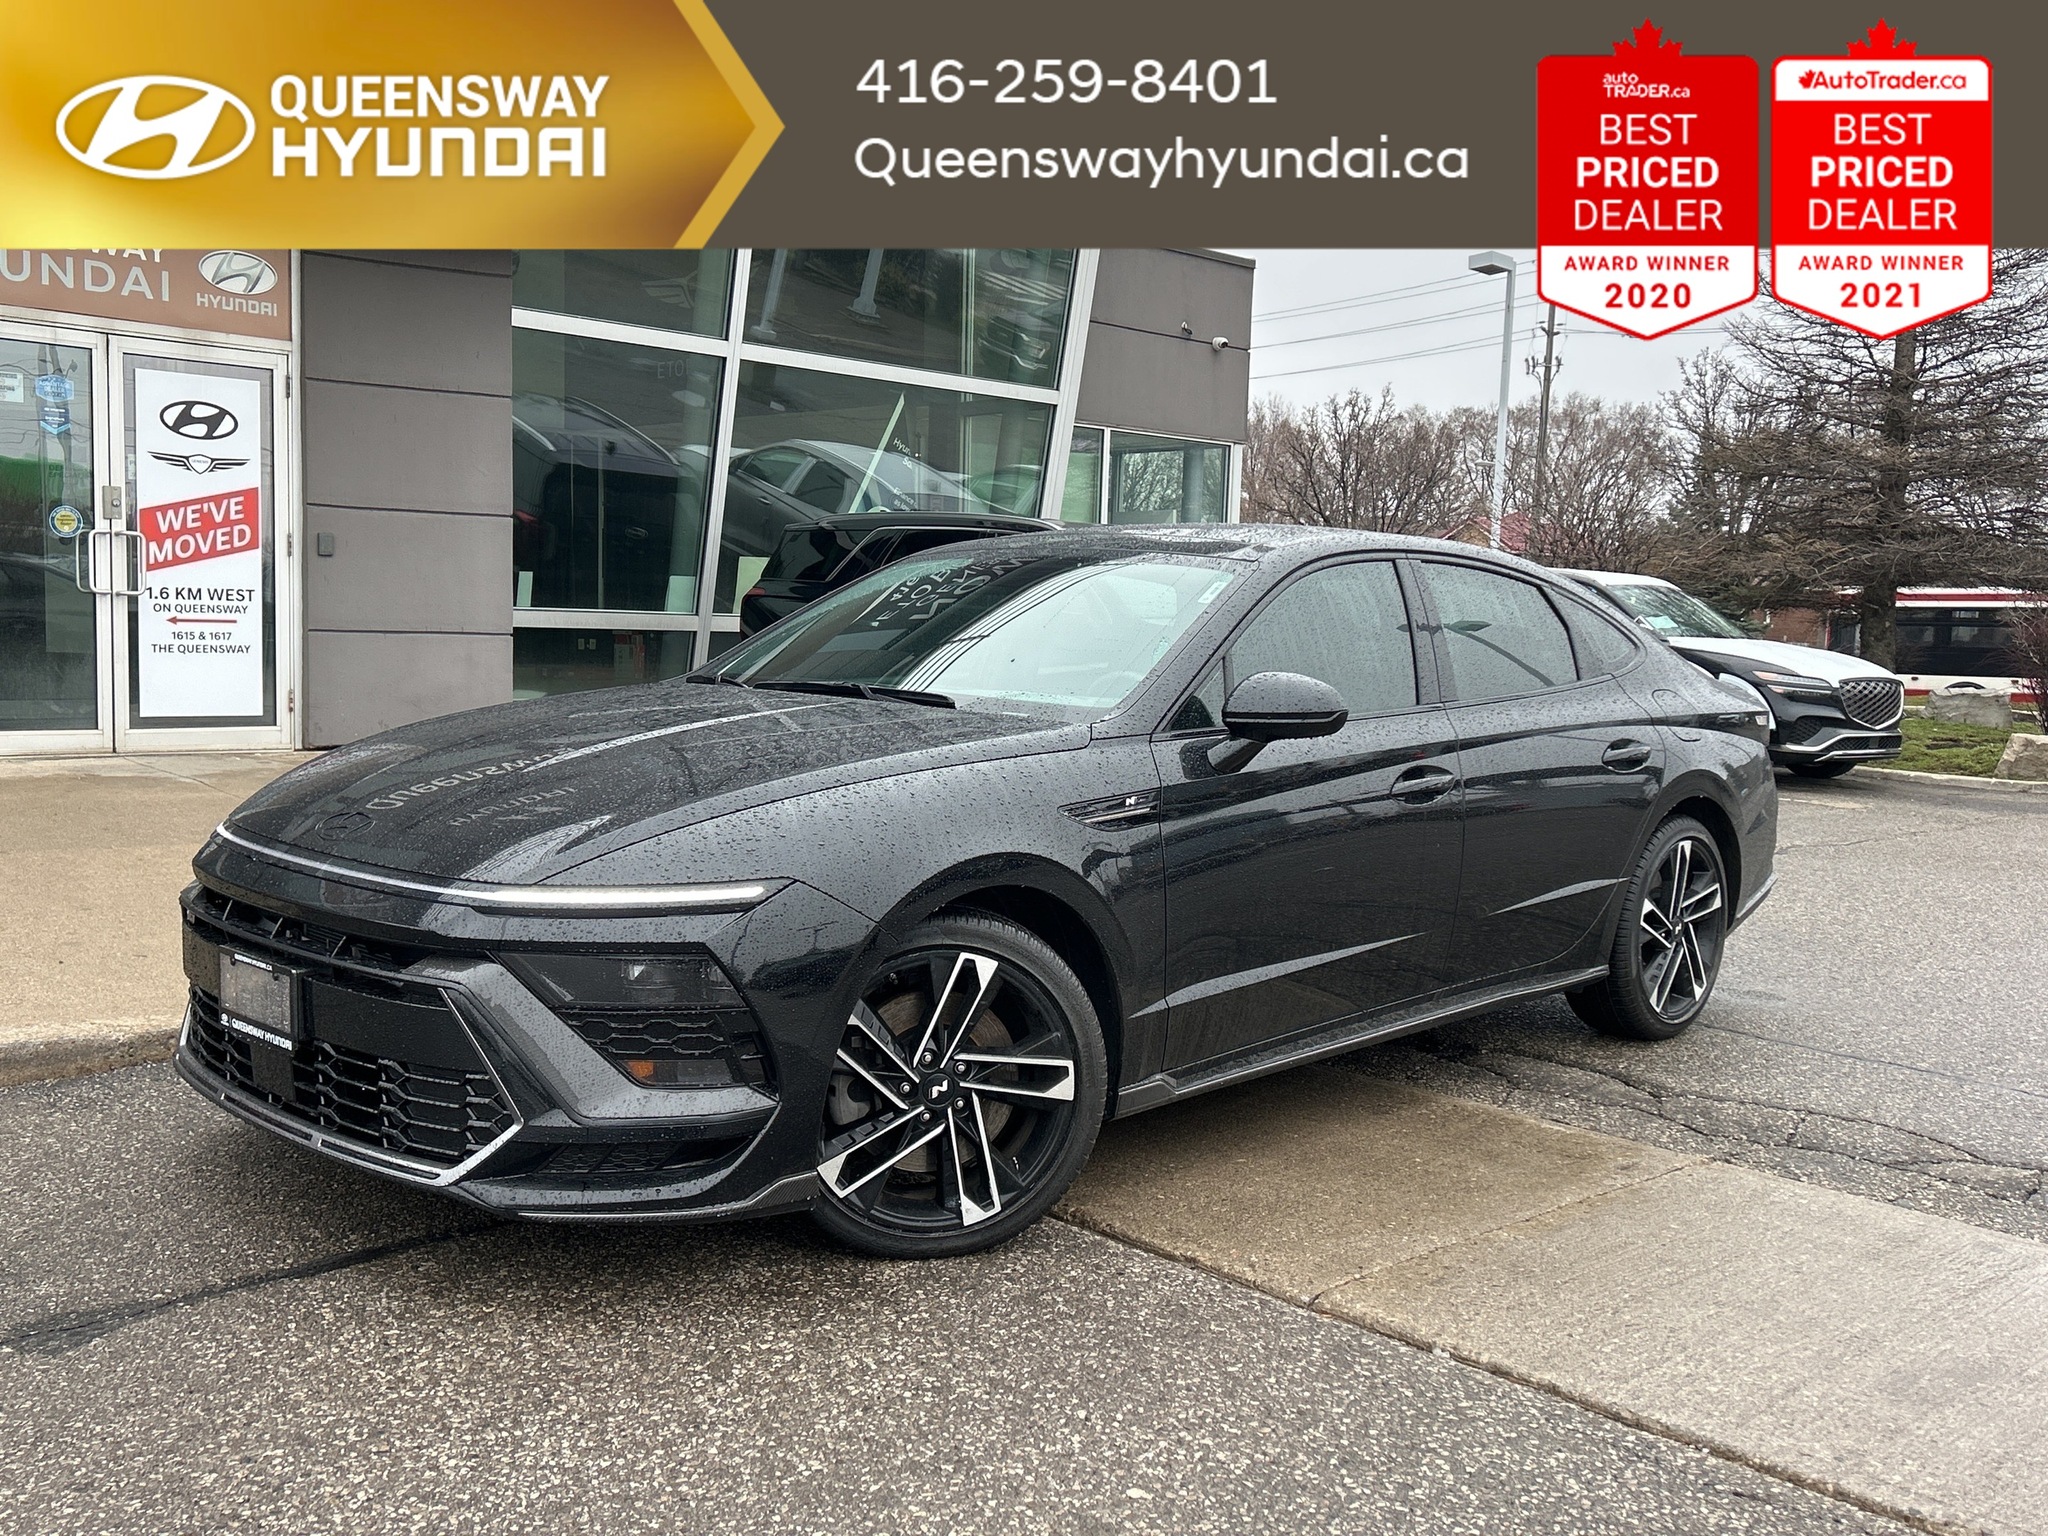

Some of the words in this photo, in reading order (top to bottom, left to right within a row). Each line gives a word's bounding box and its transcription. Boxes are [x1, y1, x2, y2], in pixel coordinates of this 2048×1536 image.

[196, 293, 278, 317] HYUNDAI
[155, 496, 245, 534] WE'VE
[148, 523, 252, 565] MOVED
[146, 586, 170, 600] 1.6
[175, 587, 202, 601] KM
[207, 588, 255, 602] WEST
[153, 603, 171, 613] ON
[174, 603, 249, 614] QUEENSWAY
[171, 631, 195, 641] 1615
[198, 631, 206, 641] &
[209, 632, 232, 641] 1617
[151, 644, 174, 653] THE
[177, 644, 251, 655] QUEENSWAY
[232, 1018, 265, 1039] QUEENSWAY
[265, 1031, 292, 1051] HYUNDAI
